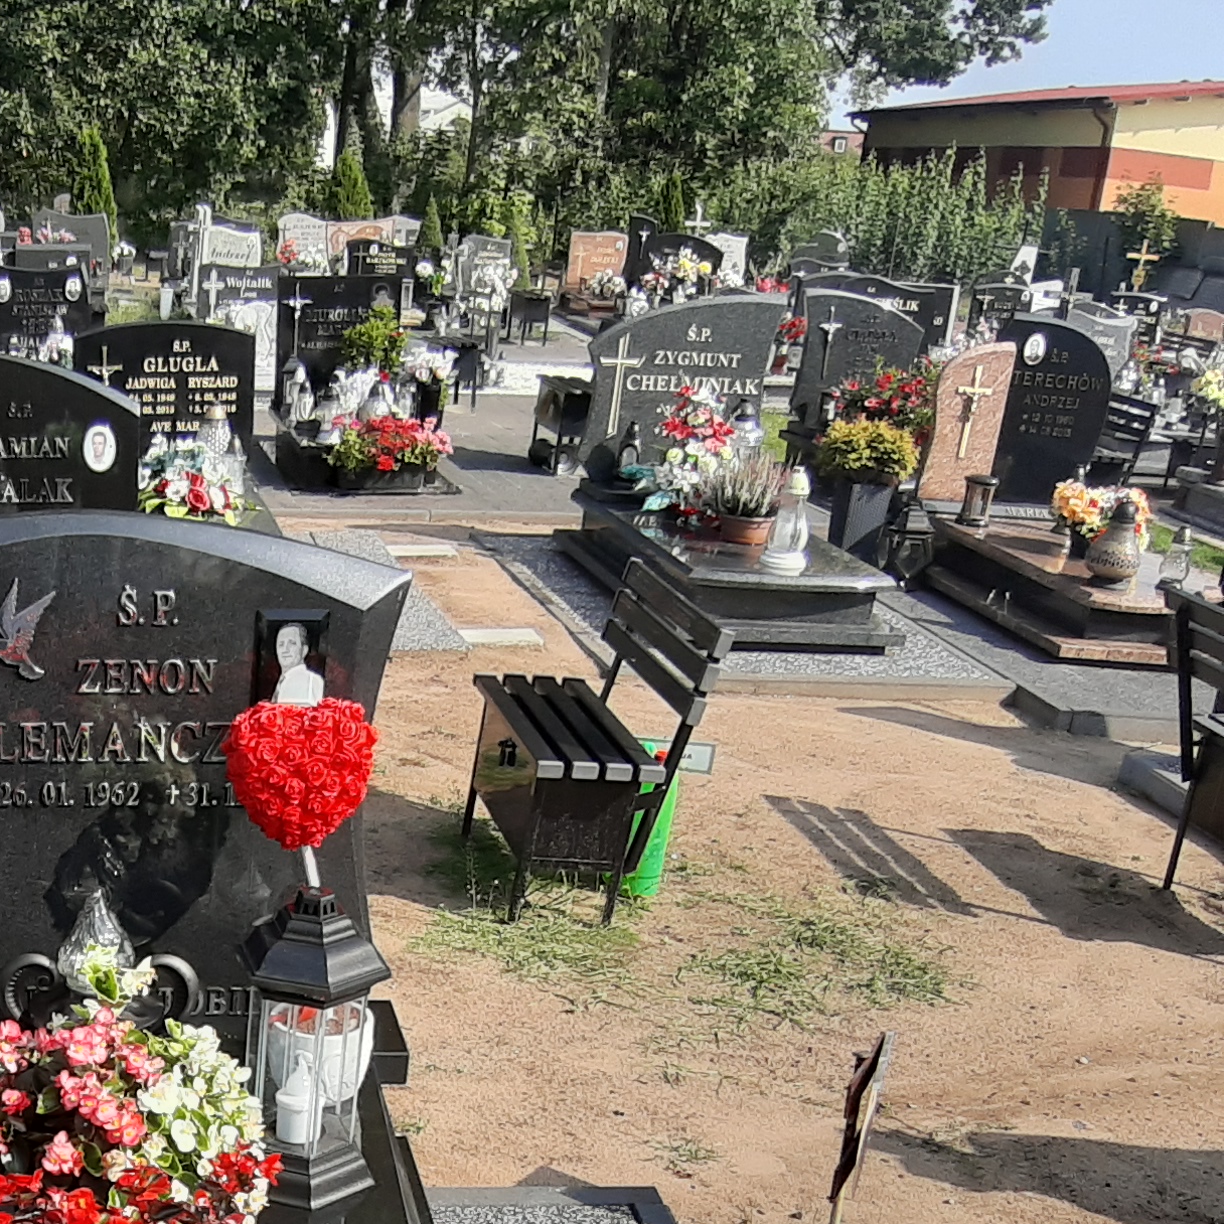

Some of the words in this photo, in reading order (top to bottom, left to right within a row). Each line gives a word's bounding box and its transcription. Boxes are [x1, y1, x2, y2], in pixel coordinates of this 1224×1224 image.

[143, 355, 220, 373] GLUGLA
[653, 350, 742, 369] ZYGMUNT
[125, 377, 176, 390] JADWIGA
[187, 375, 239, 389] RYSZARD
[1013, 369, 1105, 392] TERECHÓW
[150, 420, 172, 433] AVE
[175, 420, 201, 432] MAR
[77, 658, 219, 695] ZENON
